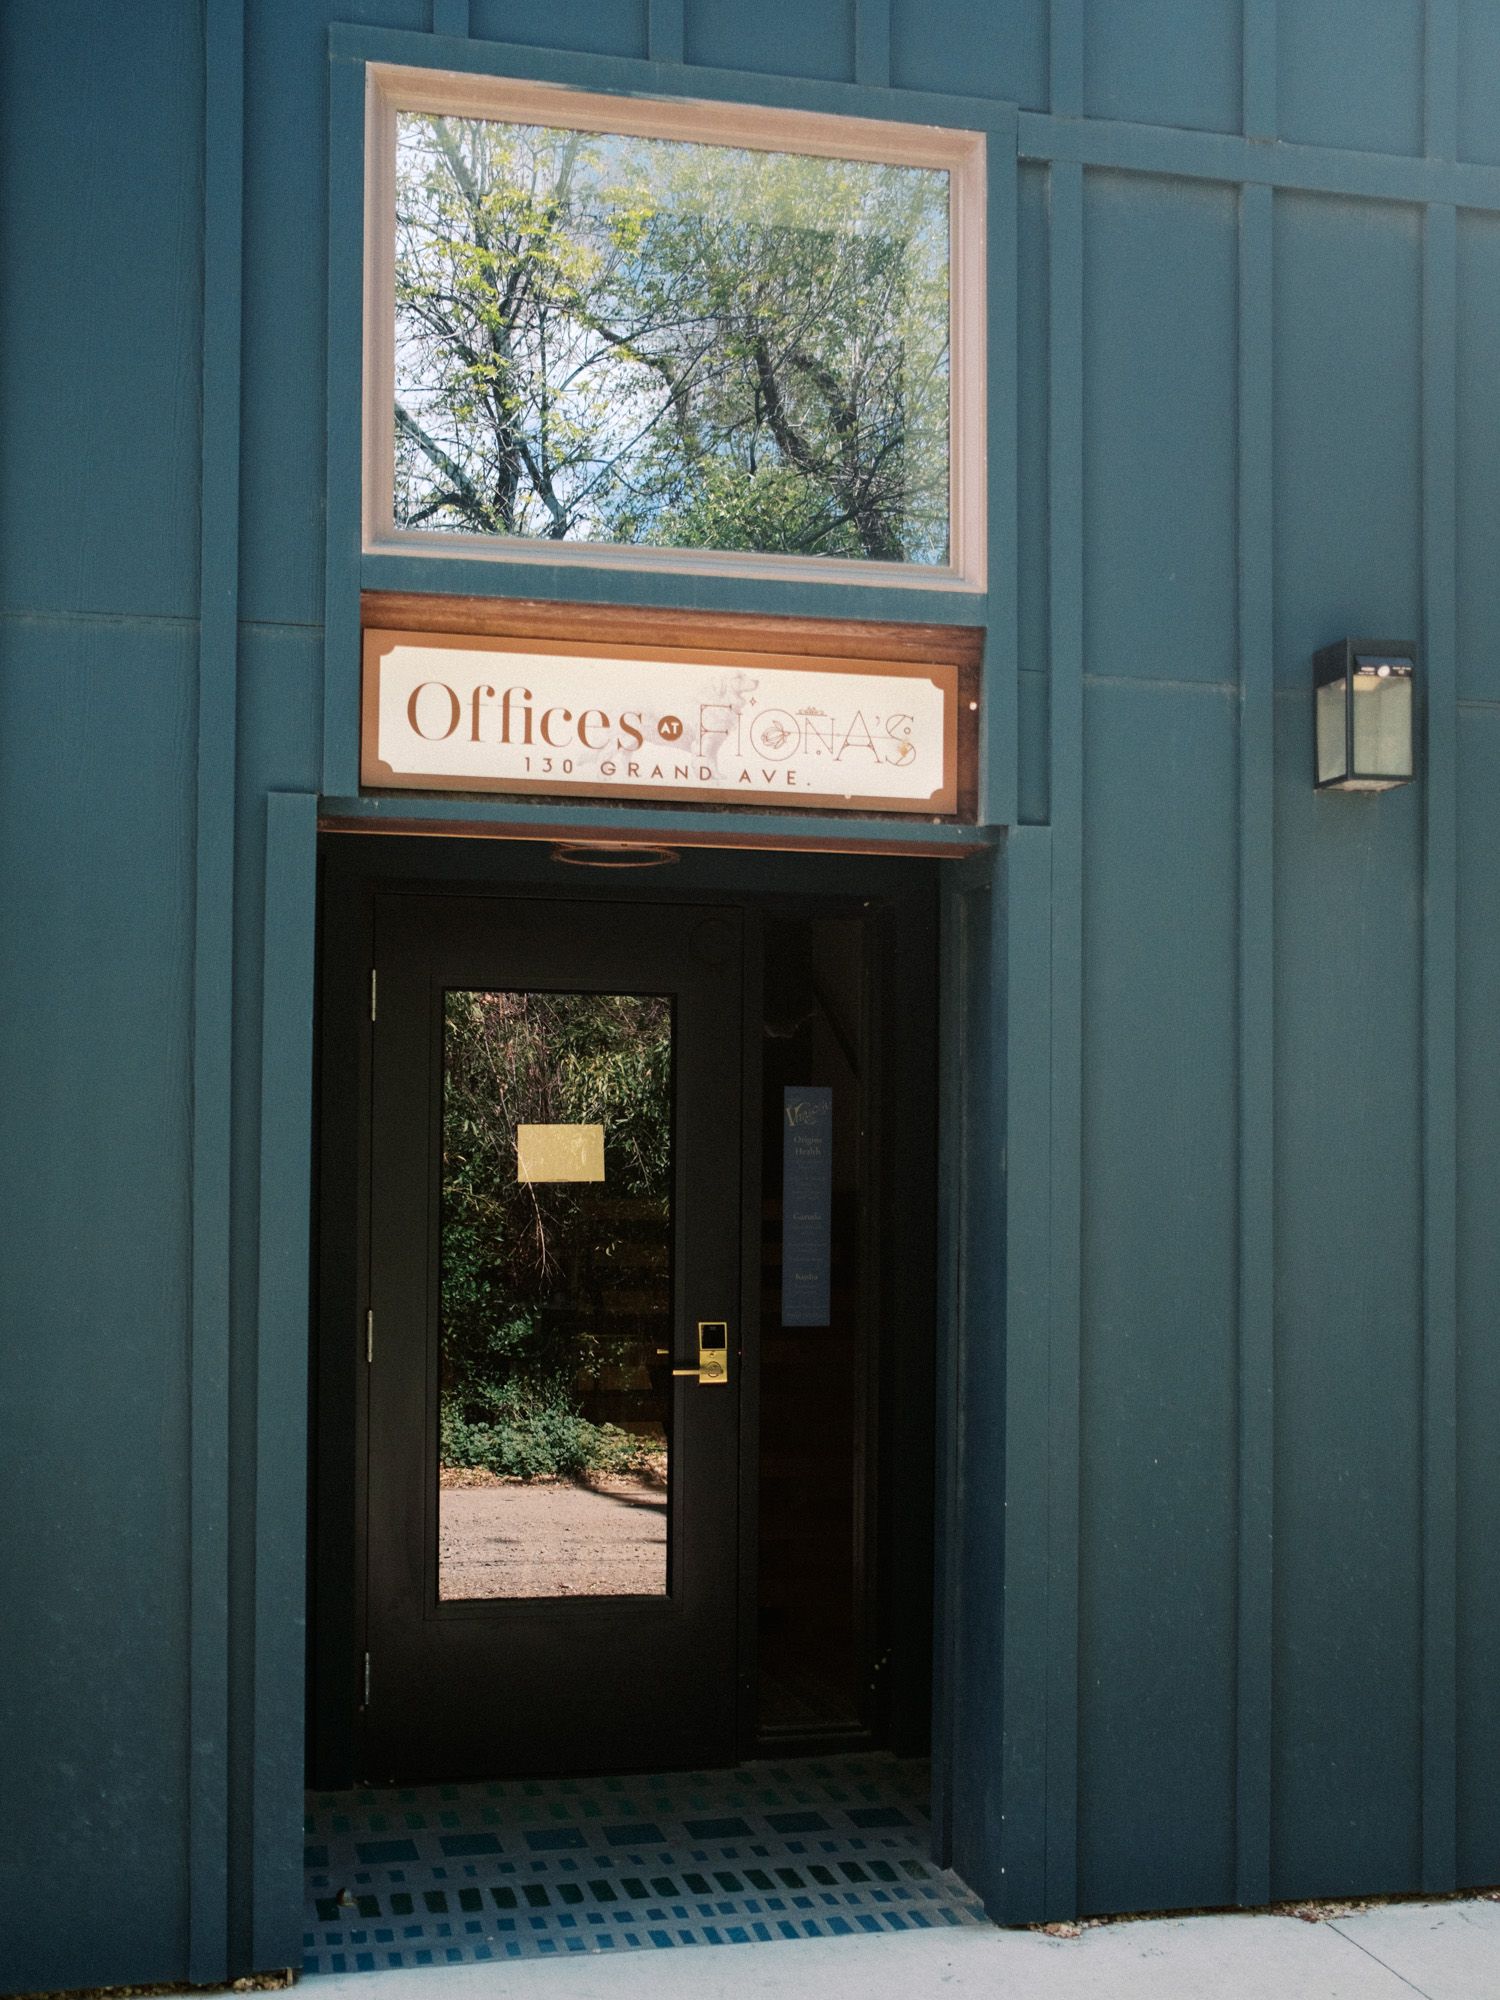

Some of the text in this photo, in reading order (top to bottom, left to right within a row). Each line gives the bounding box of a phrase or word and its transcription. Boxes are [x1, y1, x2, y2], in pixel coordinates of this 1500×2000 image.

[407, 681, 917, 767] Offices AT FIONA'S
[524, 757, 812, 787] 130 GRAND AVE.
